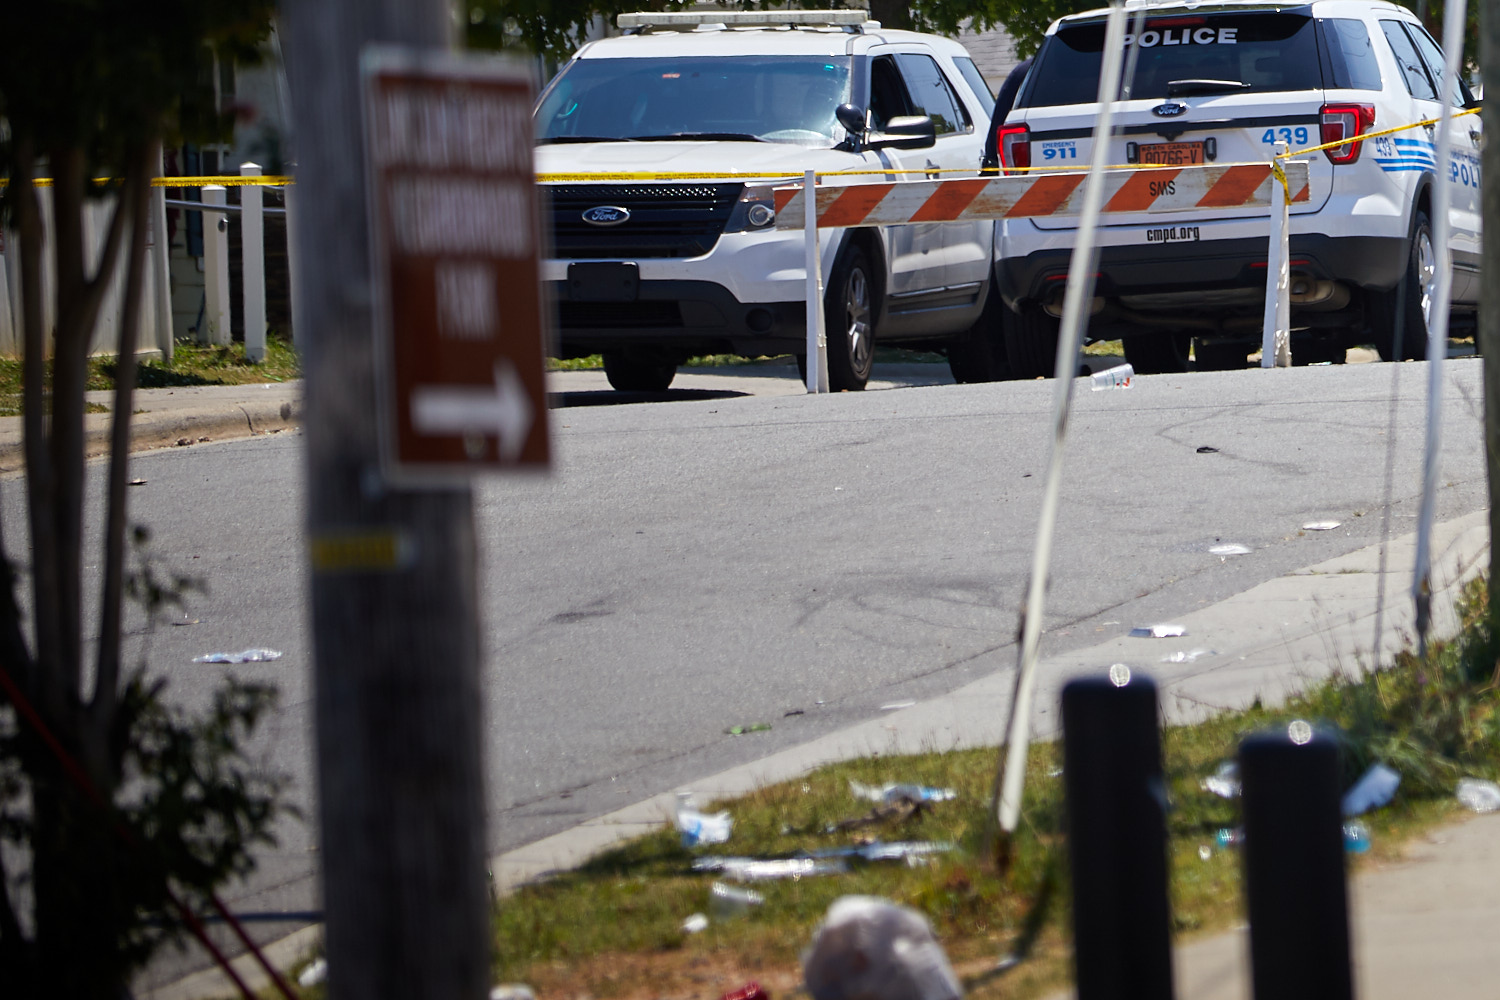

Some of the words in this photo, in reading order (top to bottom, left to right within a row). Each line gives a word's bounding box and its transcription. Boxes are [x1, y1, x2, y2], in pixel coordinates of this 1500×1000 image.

[1120, 27, 1238, 49] POLICE
[1158, 105, 1179, 115] Ford
[1262, 127, 1308, 145] 439
[1042, 141, 1076, 149] EMERGENCY
[1042, 147, 1077, 160] 911
[592, 208, 619, 221] Ford
[1147, 226, 1200, 243] cmpd.org
